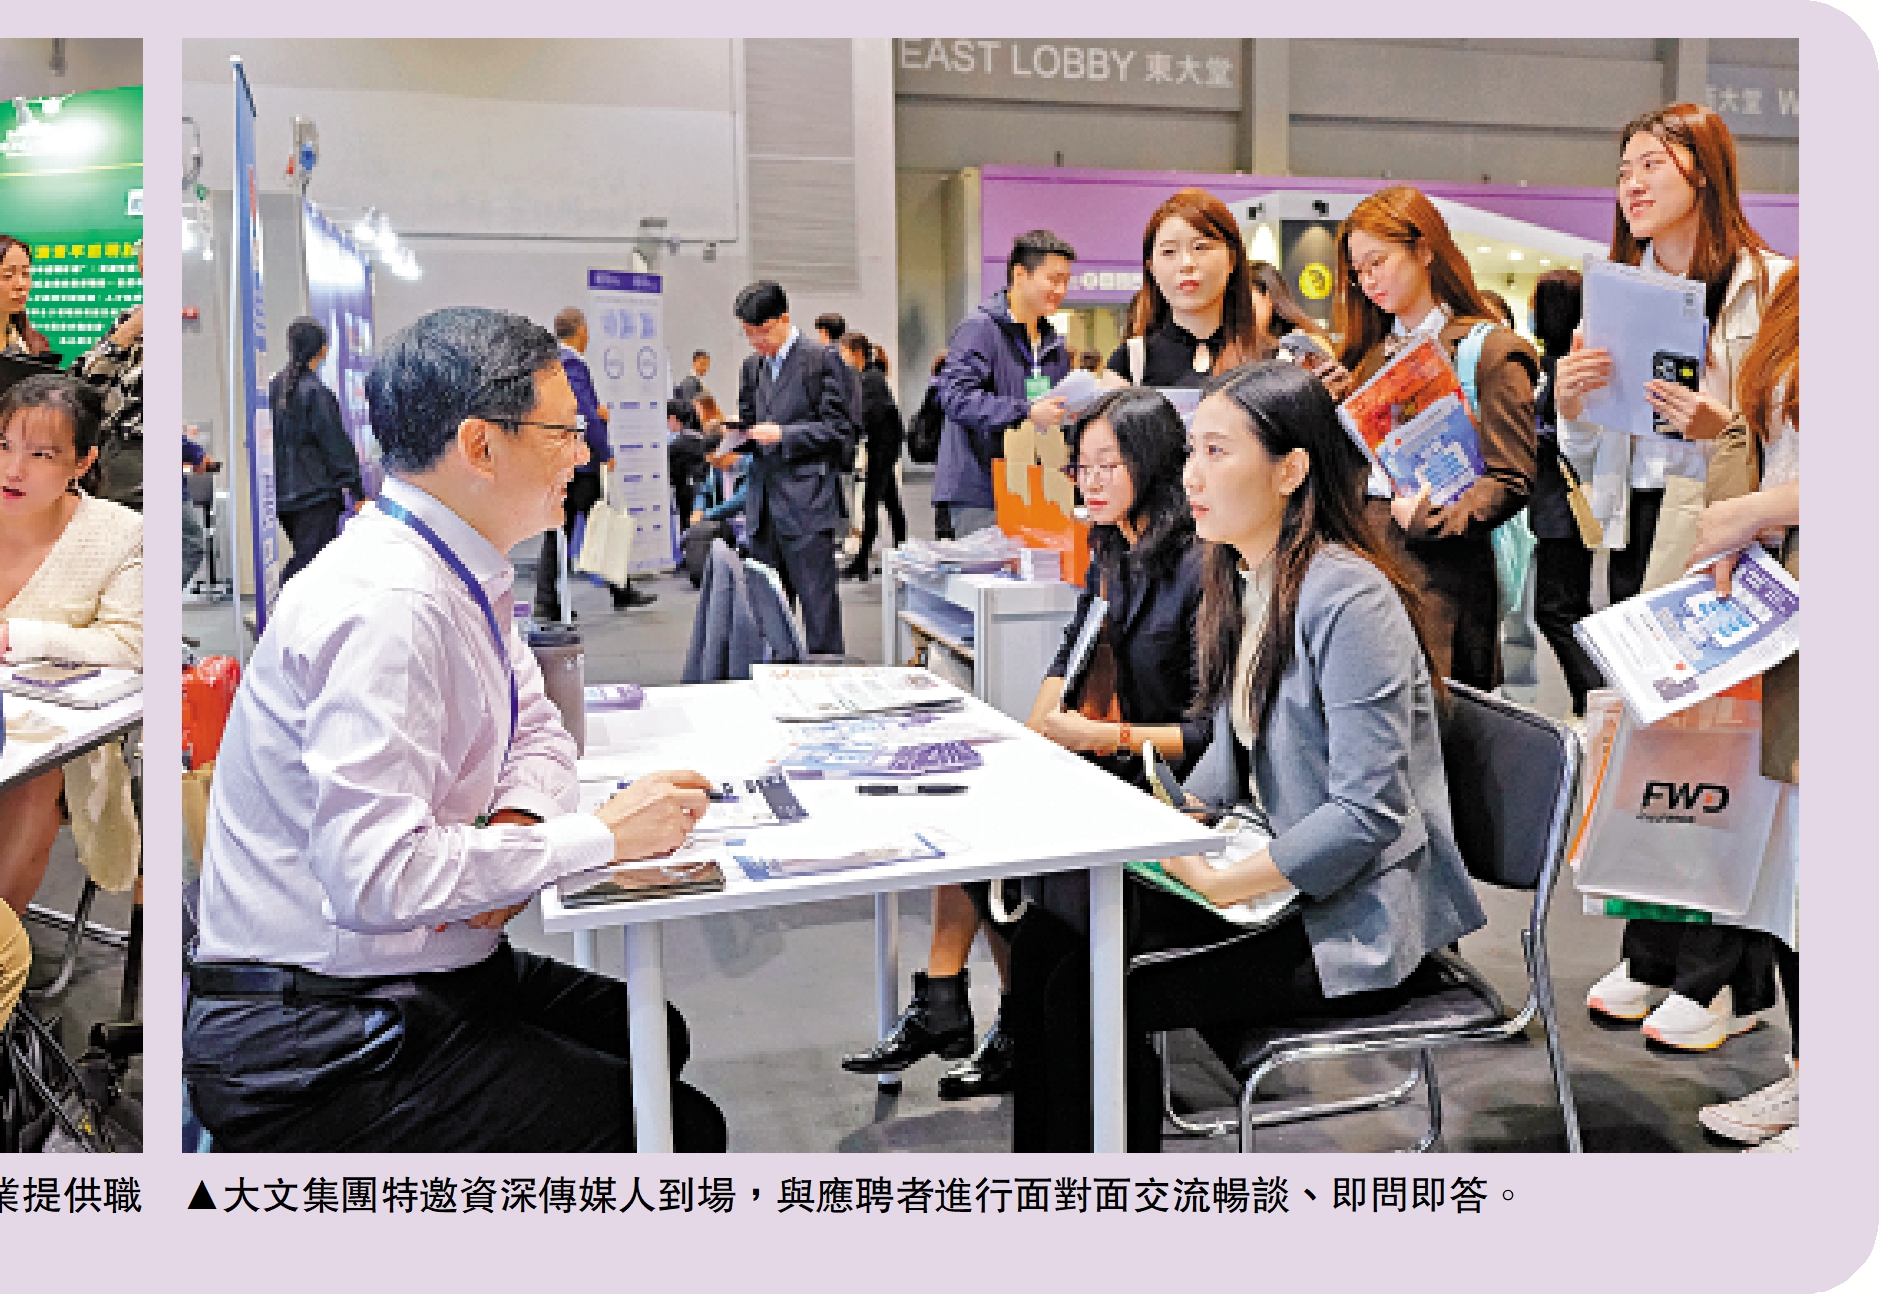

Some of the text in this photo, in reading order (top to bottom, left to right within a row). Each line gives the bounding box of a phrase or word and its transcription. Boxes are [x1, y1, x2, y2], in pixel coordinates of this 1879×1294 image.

[901, 39, 1234, 89] EAST LOBBY 東大堂
[1642, 782, 1729, 813] FWD
